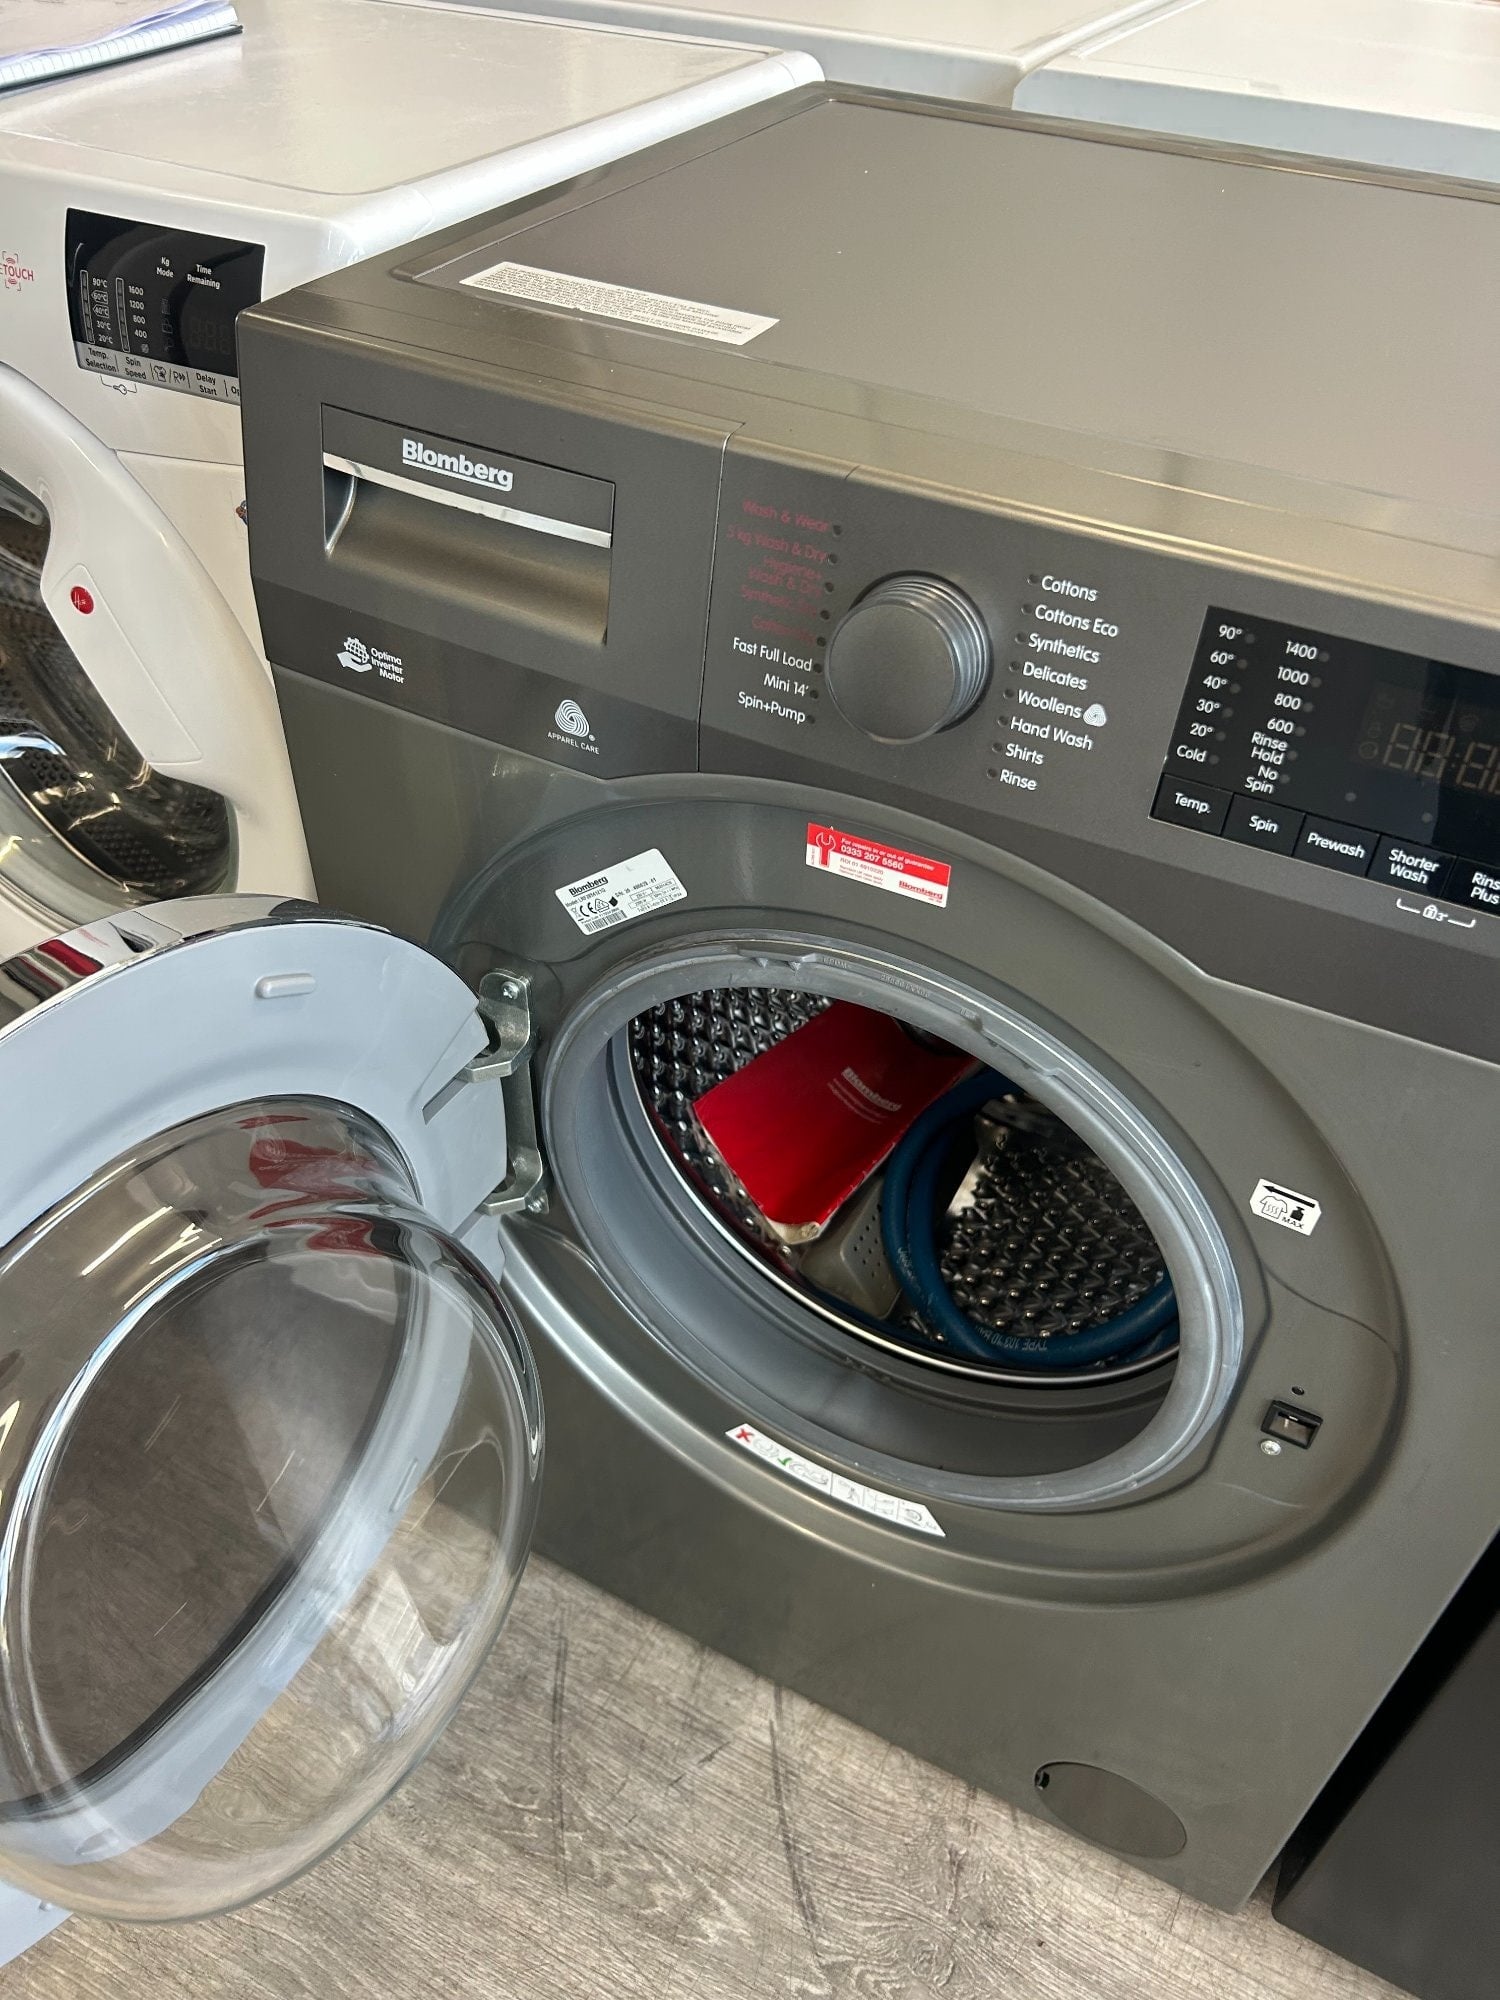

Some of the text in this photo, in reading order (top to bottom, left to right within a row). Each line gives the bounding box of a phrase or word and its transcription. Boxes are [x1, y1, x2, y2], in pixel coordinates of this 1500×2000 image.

[161, 256, 170, 267] Kg
[196, 264, 212, 275] Time
[156, 267, 174, 278] Mode
[187, 274, 221, 290] Remaining
[128, 285, 144, 296] 1600
[130, 300, 144, 310] 1200
[135, 329, 147, 339] 400
[88, 347, 109, 360] Temp.
[125, 356, 141, 367] Spin
[86, 358, 117, 372] Selection
[125, 367, 146, 380] Speed
[196, 372, 216, 386] Delay
[199, 384, 217, 396] Start
[402, 438, 514, 492] Blomberg
[1041, 575, 1099, 602] Cottons
[1034, 604, 1119, 637] Cottons Eco
[1218, 624, 1243, 640] 90°
[371, 647, 402, 666] Optima
[733, 637, 813, 672] Fast Full Load
[1028, 632, 1101, 664] Synthetics
[1285, 640, 1318, 660] 1400
[371, 656, 404, 675] Inverter
[1210, 651, 1235, 666] 60°
[379, 668, 405, 684] Motor
[763, 673, 790, 692] Mini
[1022, 661, 1089, 690] Delicates
[1202, 675, 1228, 690] 40°
[1277, 666, 1310, 686] 1000
[737, 691, 806, 725] Spin+Pump
[1018, 689, 1082, 719] Woollens
[1196, 698, 1221, 714] 30°
[1274, 692, 1302, 711] 800
[1010, 716, 1094, 751] Hand Wash
[1189, 722, 1214, 738] 20°
[1267, 718, 1294, 735] 600
[547, 731, 600, 755] APPAREL CARE
[1251, 731, 1289, 752] Rinse
[1005, 743, 1045, 765] Shirts
[1176, 744, 1207, 763] Cold
[1250, 747, 1285, 766] Hold
[999, 768, 1038, 791] Rinse
[1257, 764, 1279, 781] No
[1245, 776, 1275, 795] Spin
[1174, 792, 1211, 814] Temp.
[1248, 815, 1279, 834] Spin
[1306, 832, 1366, 859] Prewash
[840, 845, 904, 871] 0333 207 5560
[1388, 848, 1440, 872] Shorter
[1390, 863, 1429, 884] Wash
[1471, 872, 1500, 890] Rins
[568, 876, 609, 898] Blomberg
[899, 880, 944, 900] Blomberg
[1470, 886, 1500, 905] Plus
[1282, 1216, 1304, 1229] MAX
